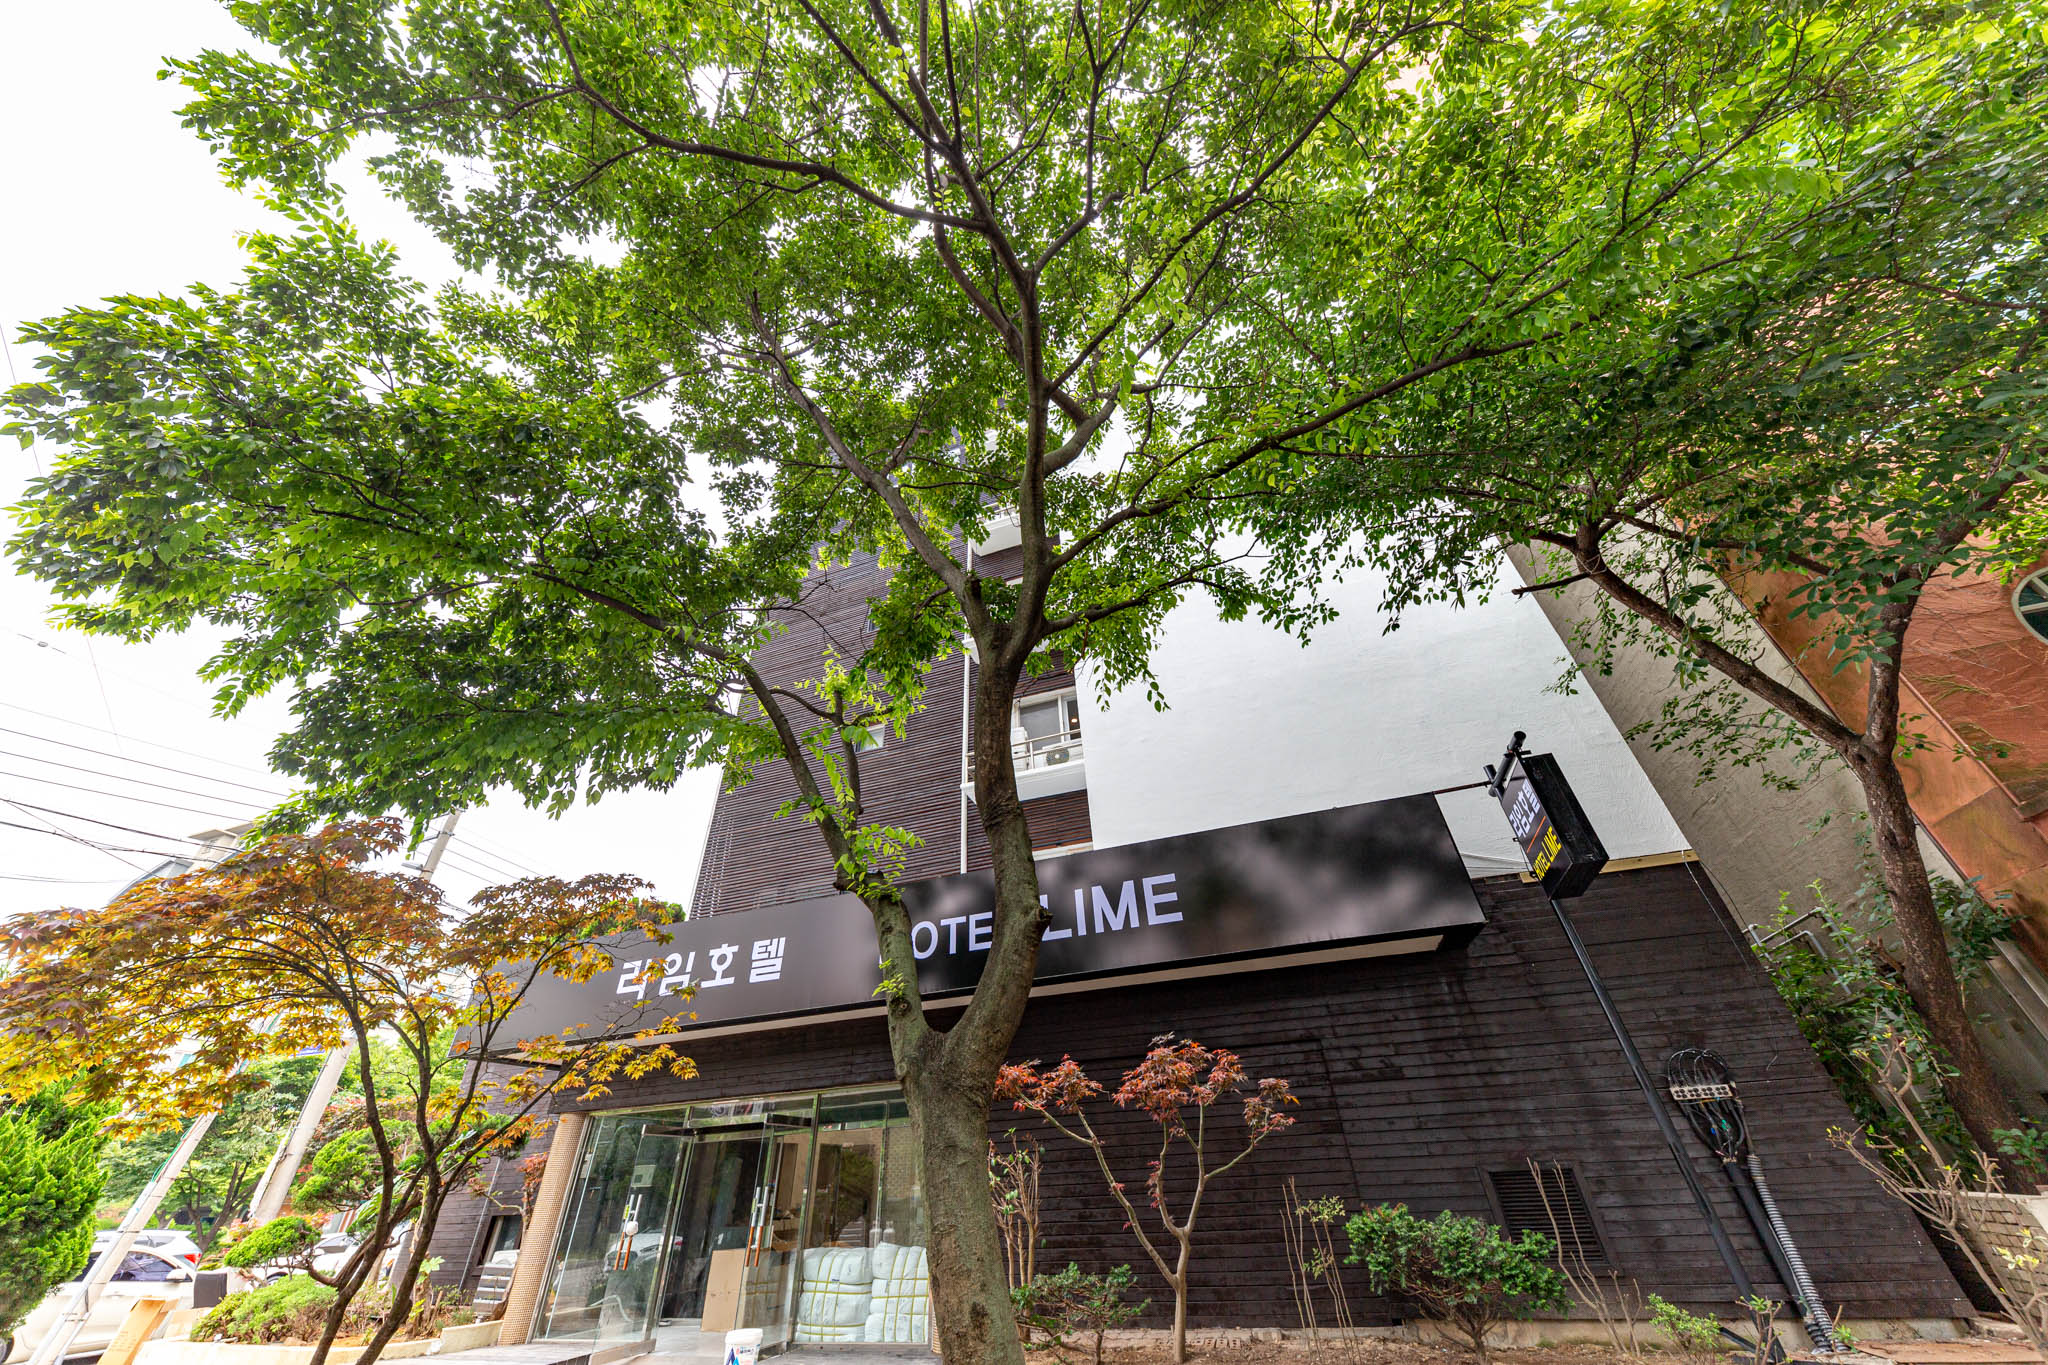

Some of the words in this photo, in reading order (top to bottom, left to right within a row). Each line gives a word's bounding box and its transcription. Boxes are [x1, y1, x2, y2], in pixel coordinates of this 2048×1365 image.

[1541, 826, 1562, 863] LIME
[1533, 851, 1551, 881] HOTEL
[880, 911, 996, 964] OTE
[1040, 873, 1184, 941] LIME
